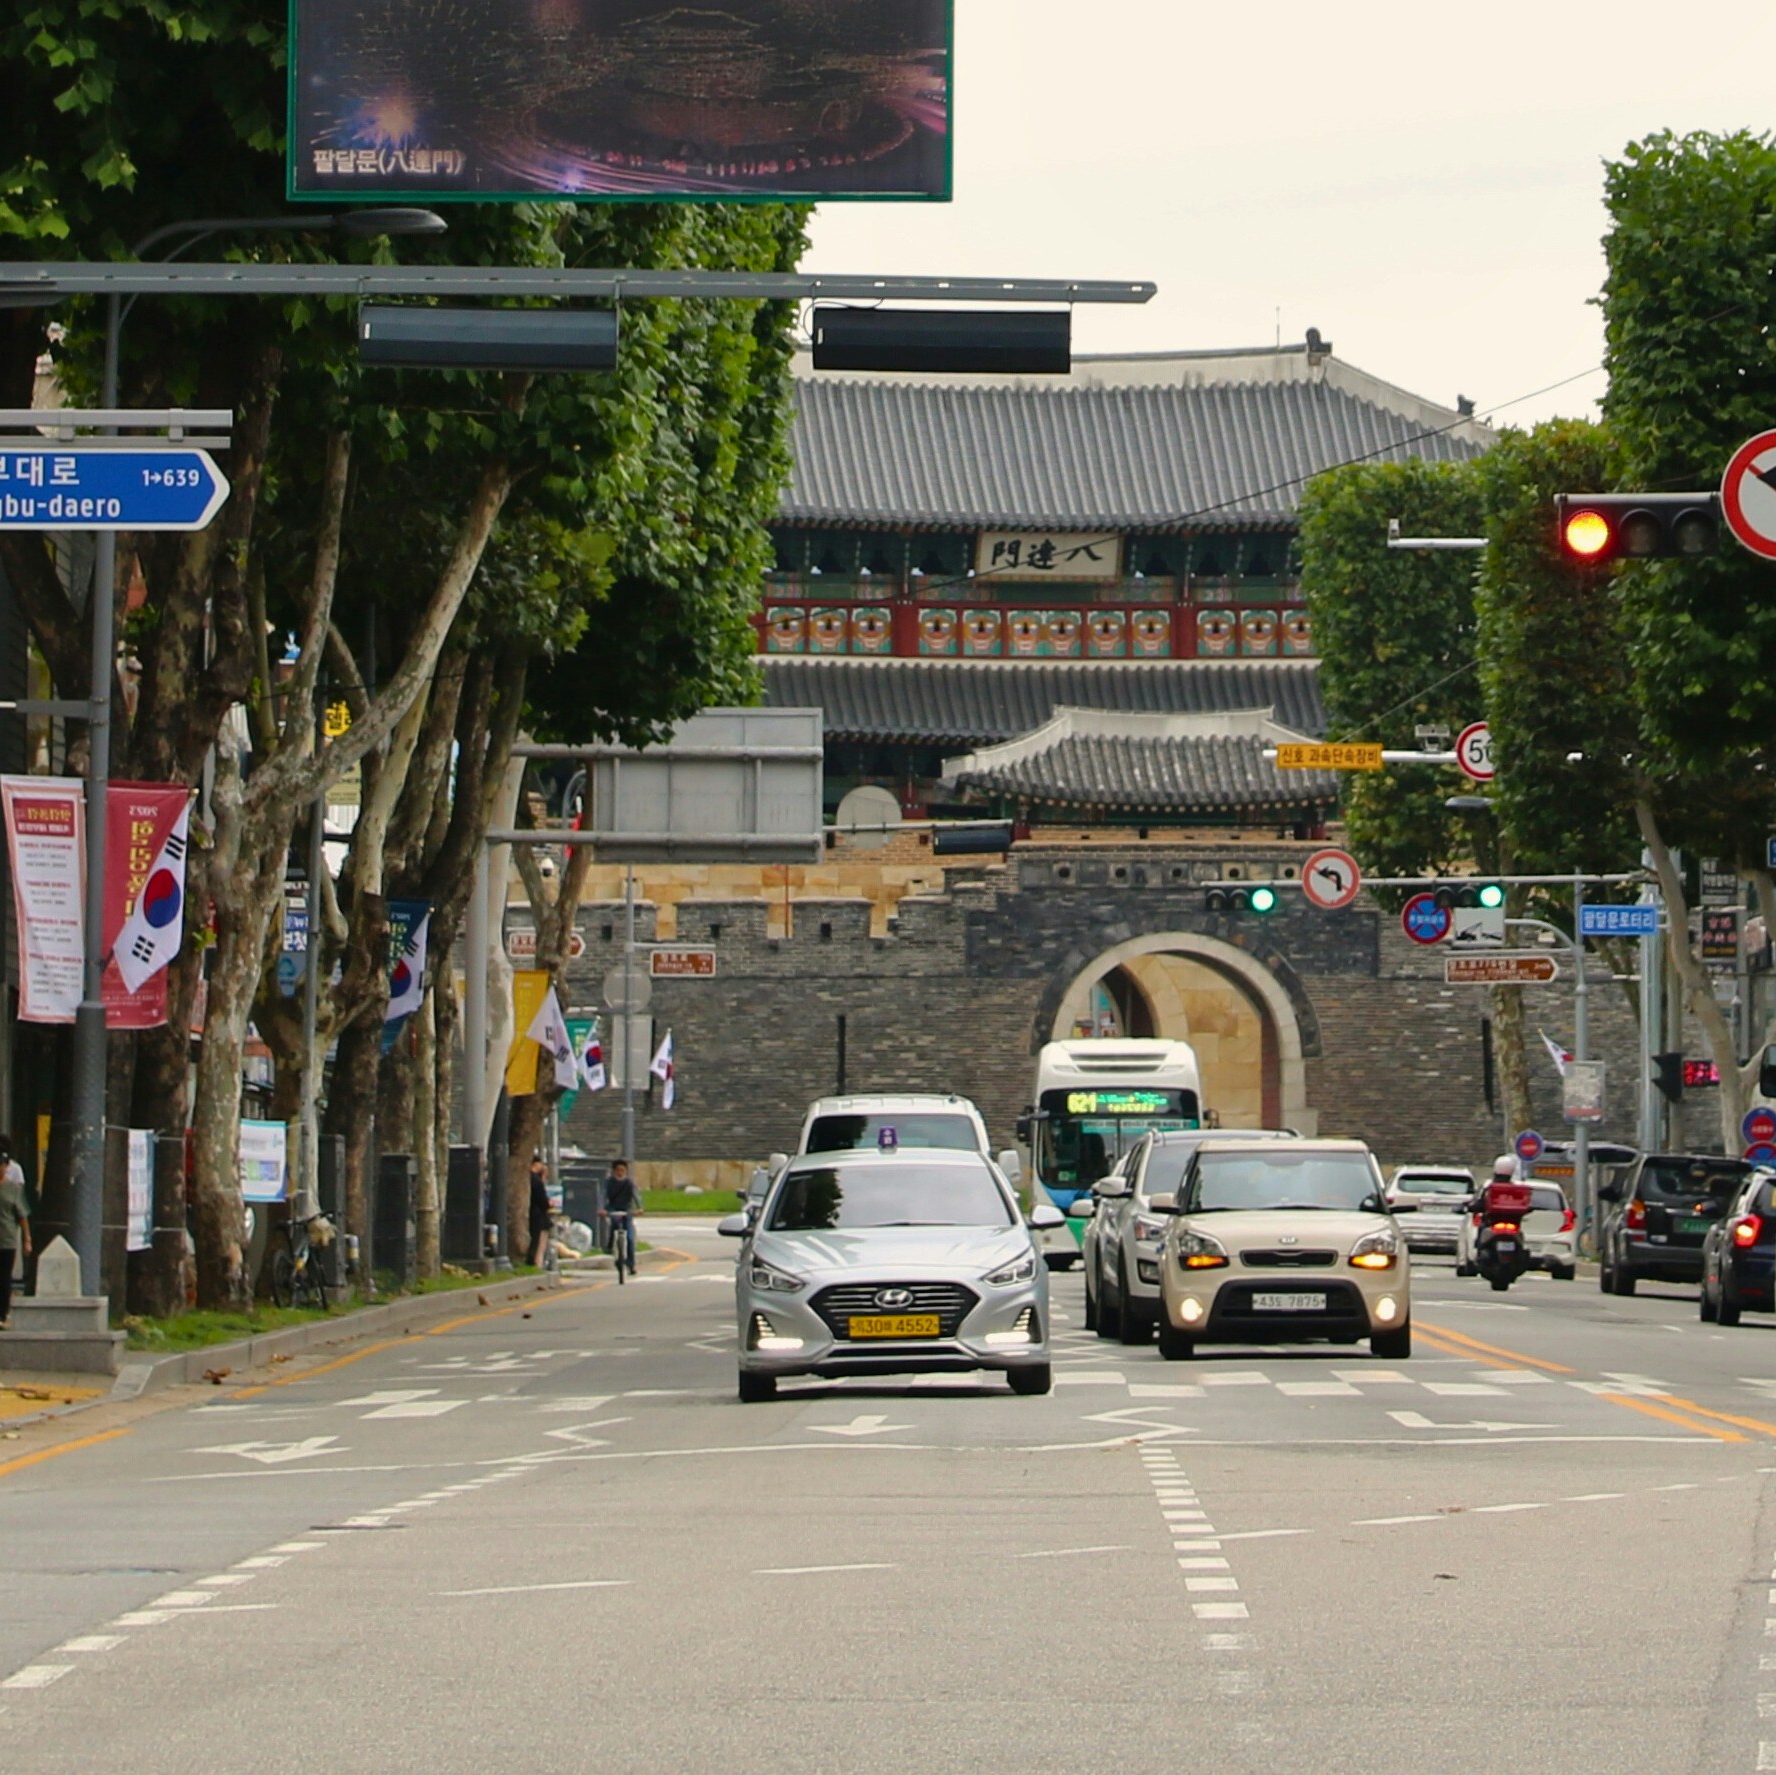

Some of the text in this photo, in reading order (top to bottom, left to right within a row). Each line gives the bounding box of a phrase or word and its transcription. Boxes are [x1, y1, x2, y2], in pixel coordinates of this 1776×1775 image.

[1282, 748, 1378, 765] 신호 과속단속장비
[896, 1317, 933, 1334] 4552
